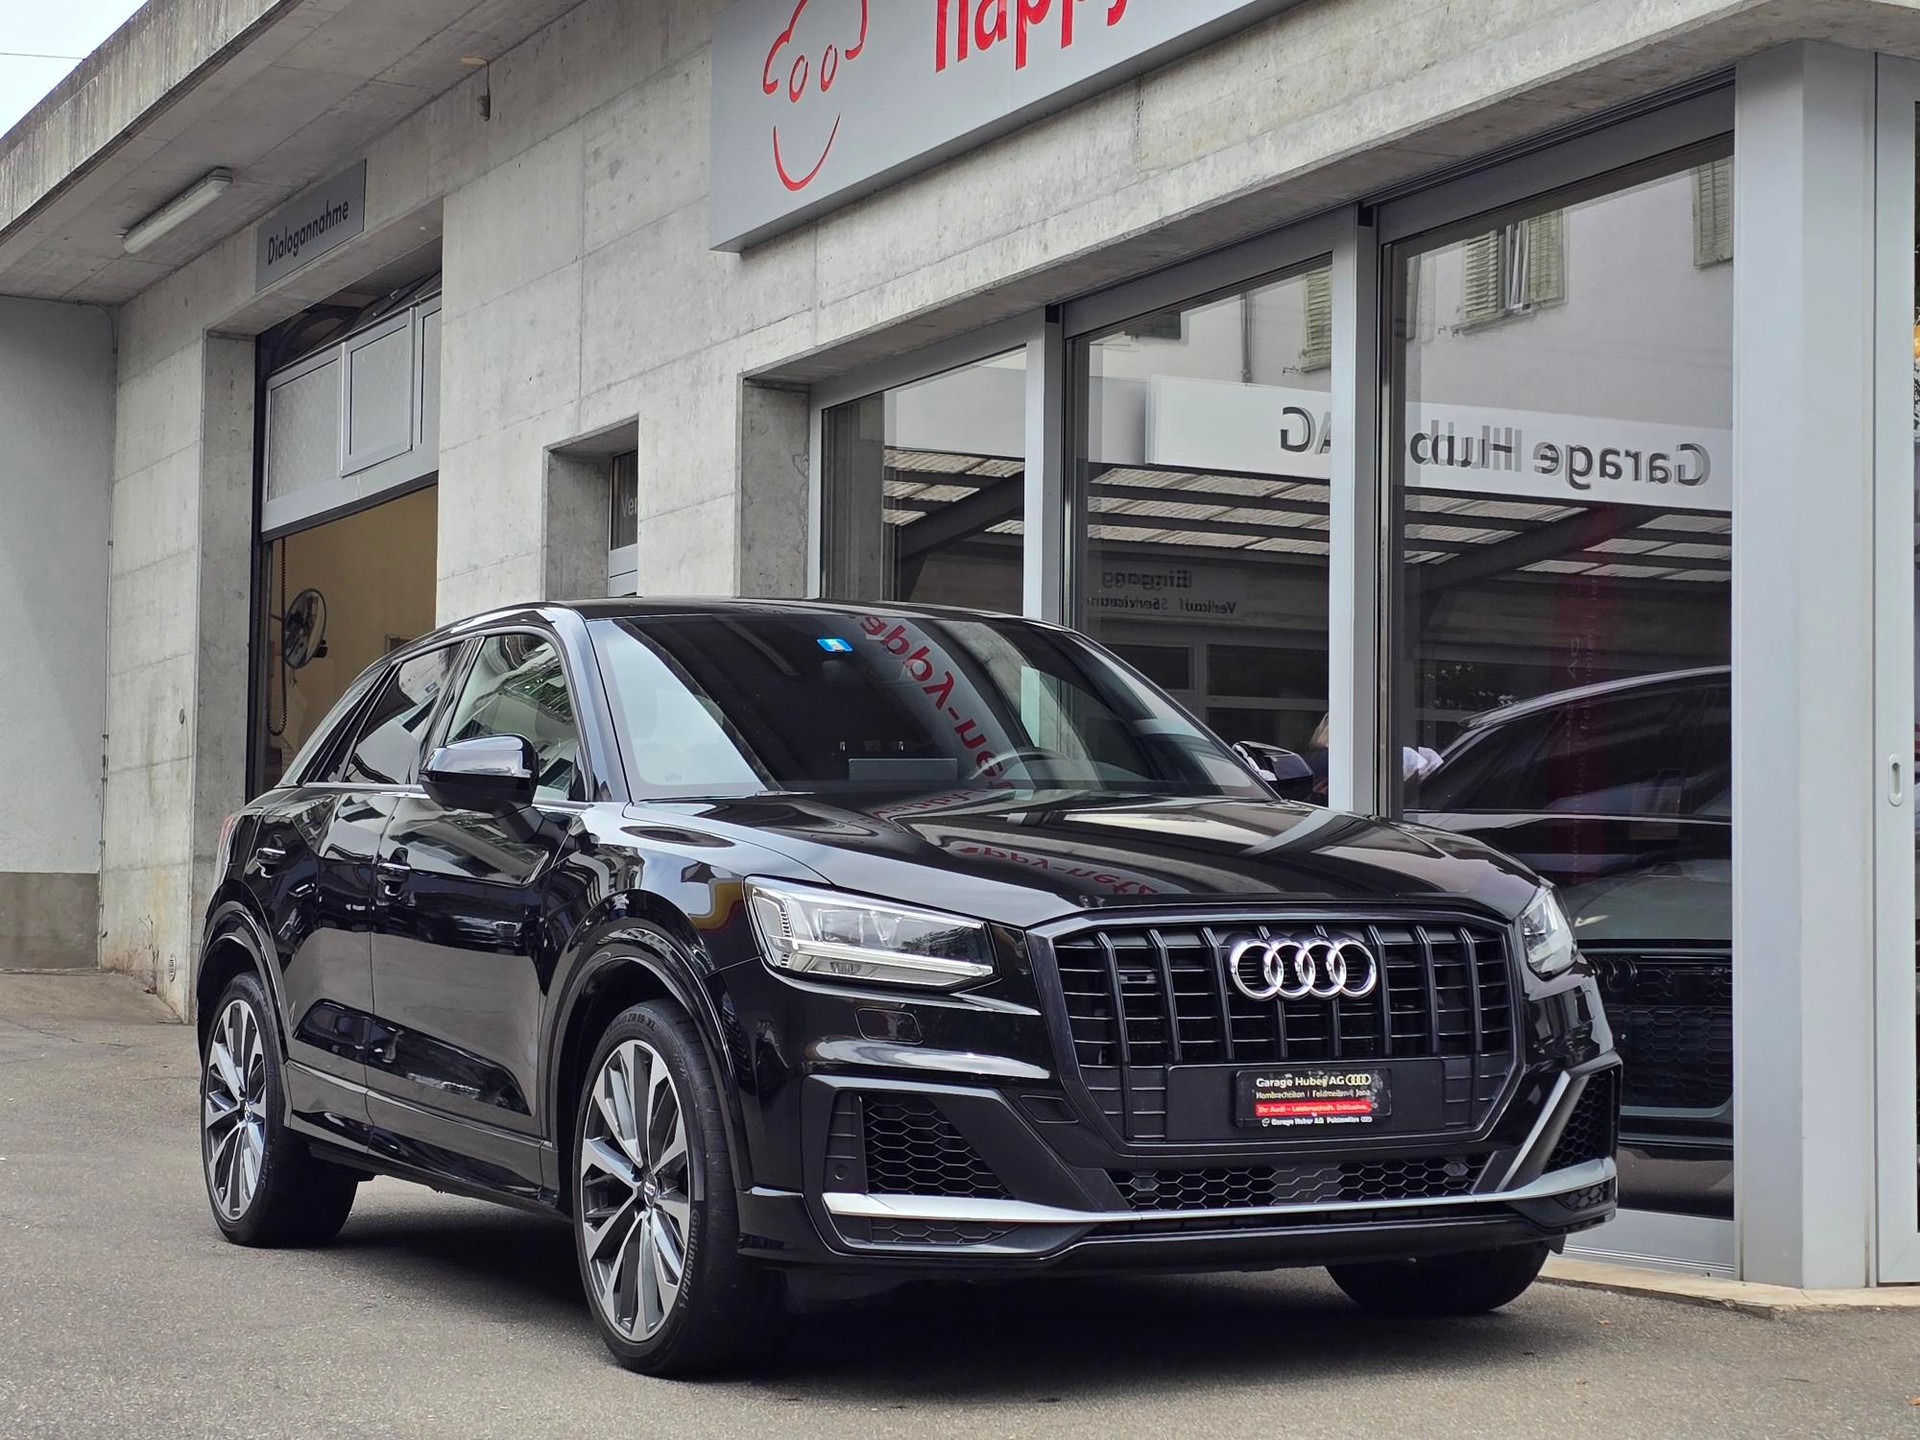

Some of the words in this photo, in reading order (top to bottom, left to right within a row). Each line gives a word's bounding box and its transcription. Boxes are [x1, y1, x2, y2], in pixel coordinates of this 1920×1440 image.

[268, 200, 349, 266] Dialogannahme
[1256, 1077, 1293, 1088] Garage
[1329, 1076, 1345, 1085] AG
[680, 1208, 701, 1300] Continental
